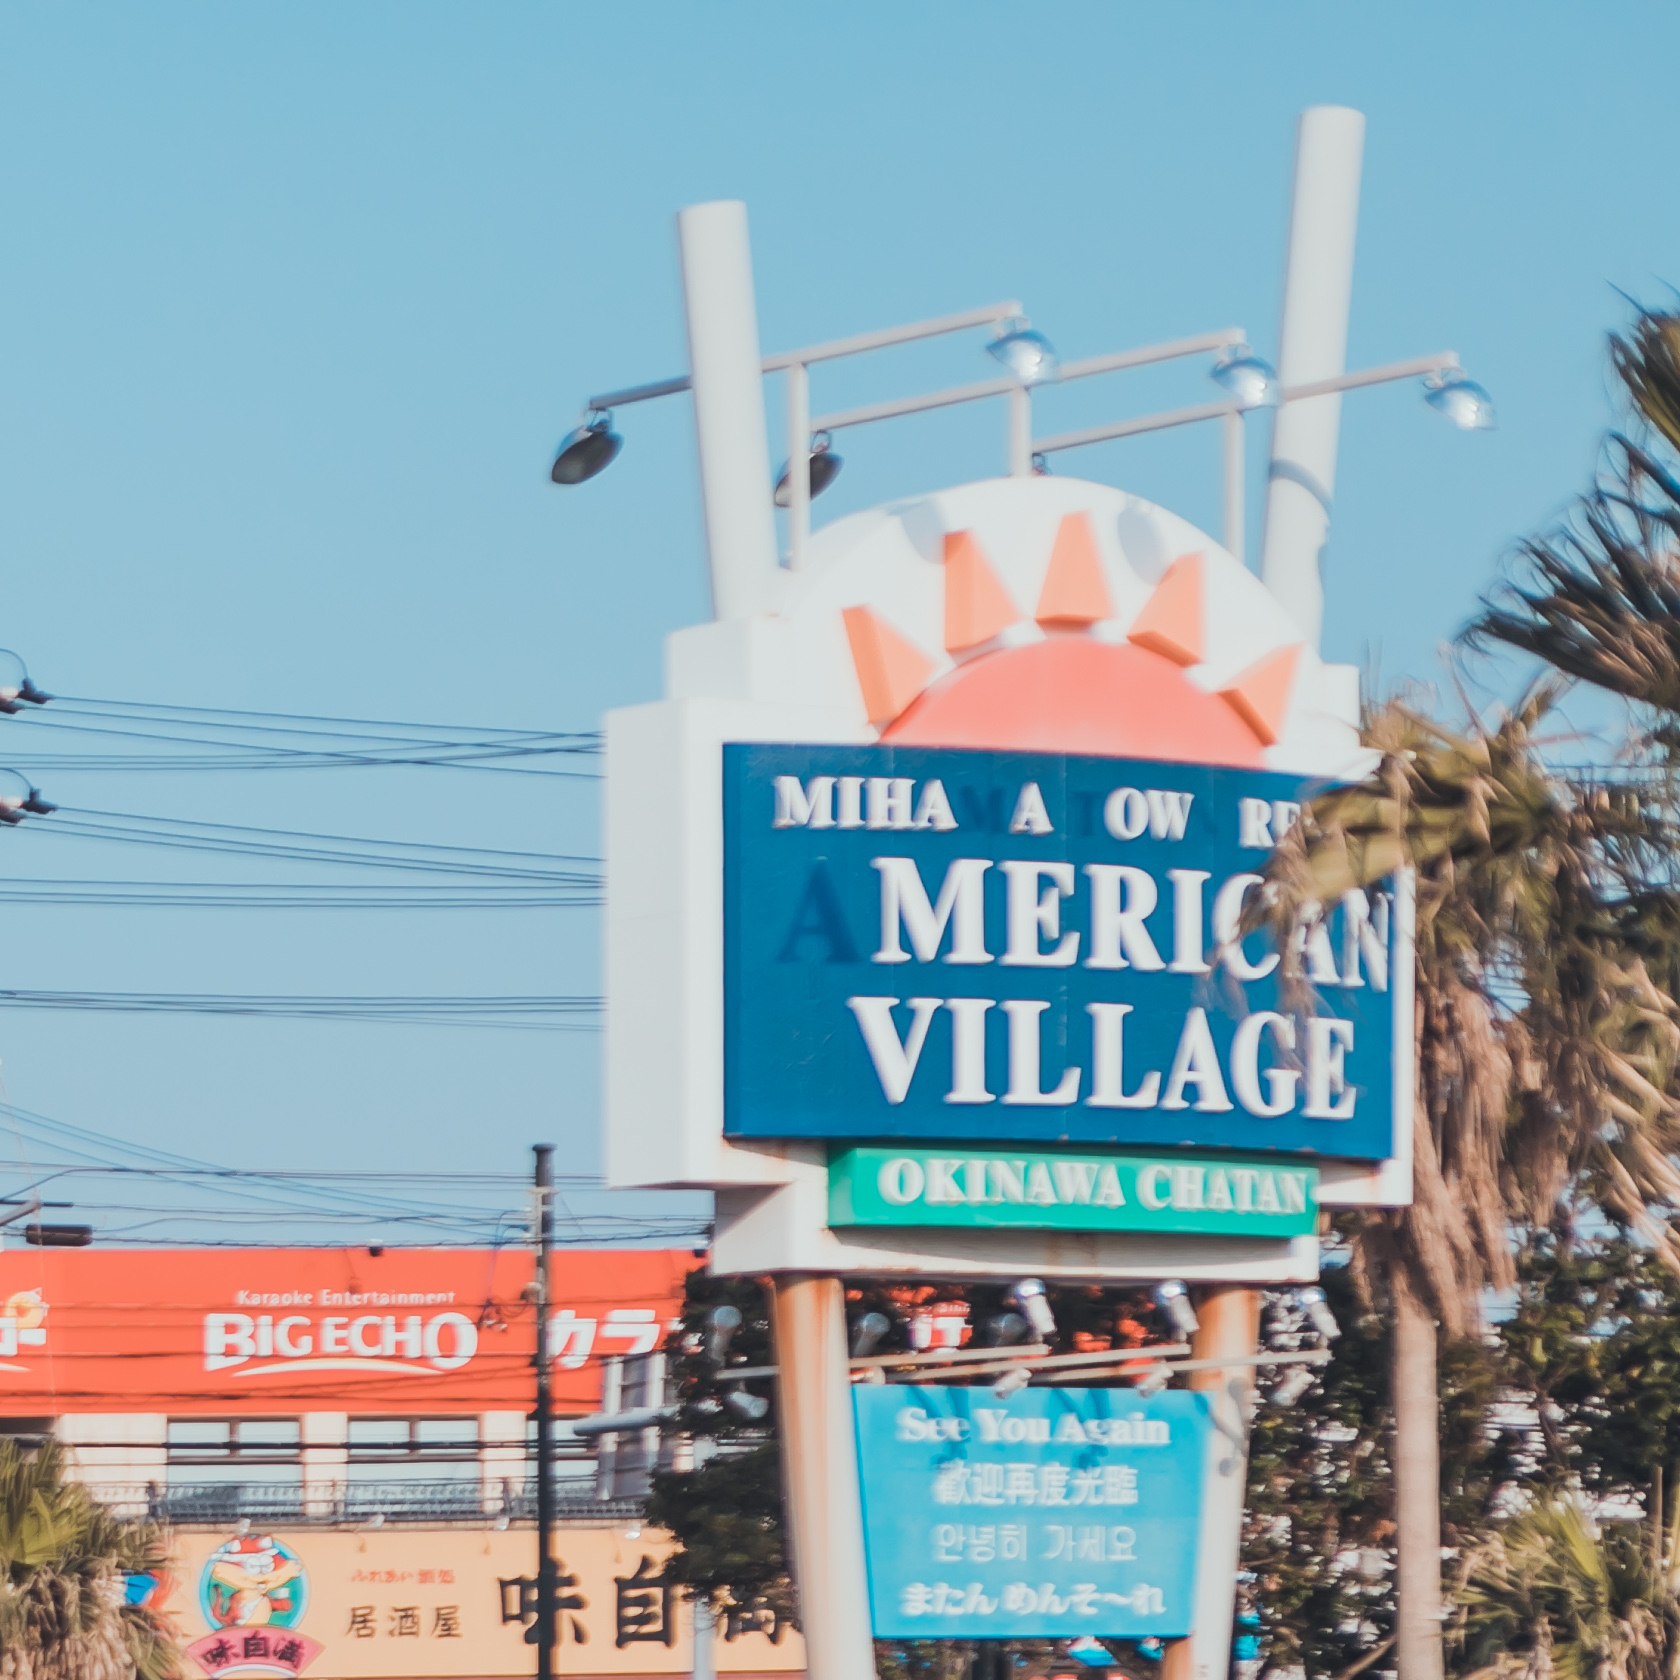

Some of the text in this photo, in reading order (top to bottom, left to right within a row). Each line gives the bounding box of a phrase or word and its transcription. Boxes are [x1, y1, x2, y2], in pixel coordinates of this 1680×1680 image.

[848, 995, 1358, 1120] VILLAGE
[878, 1157, 1308, 1216] OKINAWA CHATAN
[237, 1289, 456, 1305] Karaoke Entertainment
[204, 1312, 478, 1371] BIG ECHO
[896, 1407, 1171, 1447] See You Again
[933, 1523, 1138, 1562] 안녕히 가세요
[900, 1581, 999, 1617] またん
[346, 1605, 463, 1639] 居酒屋
[202, 1631, 305, 1669] 味自満
